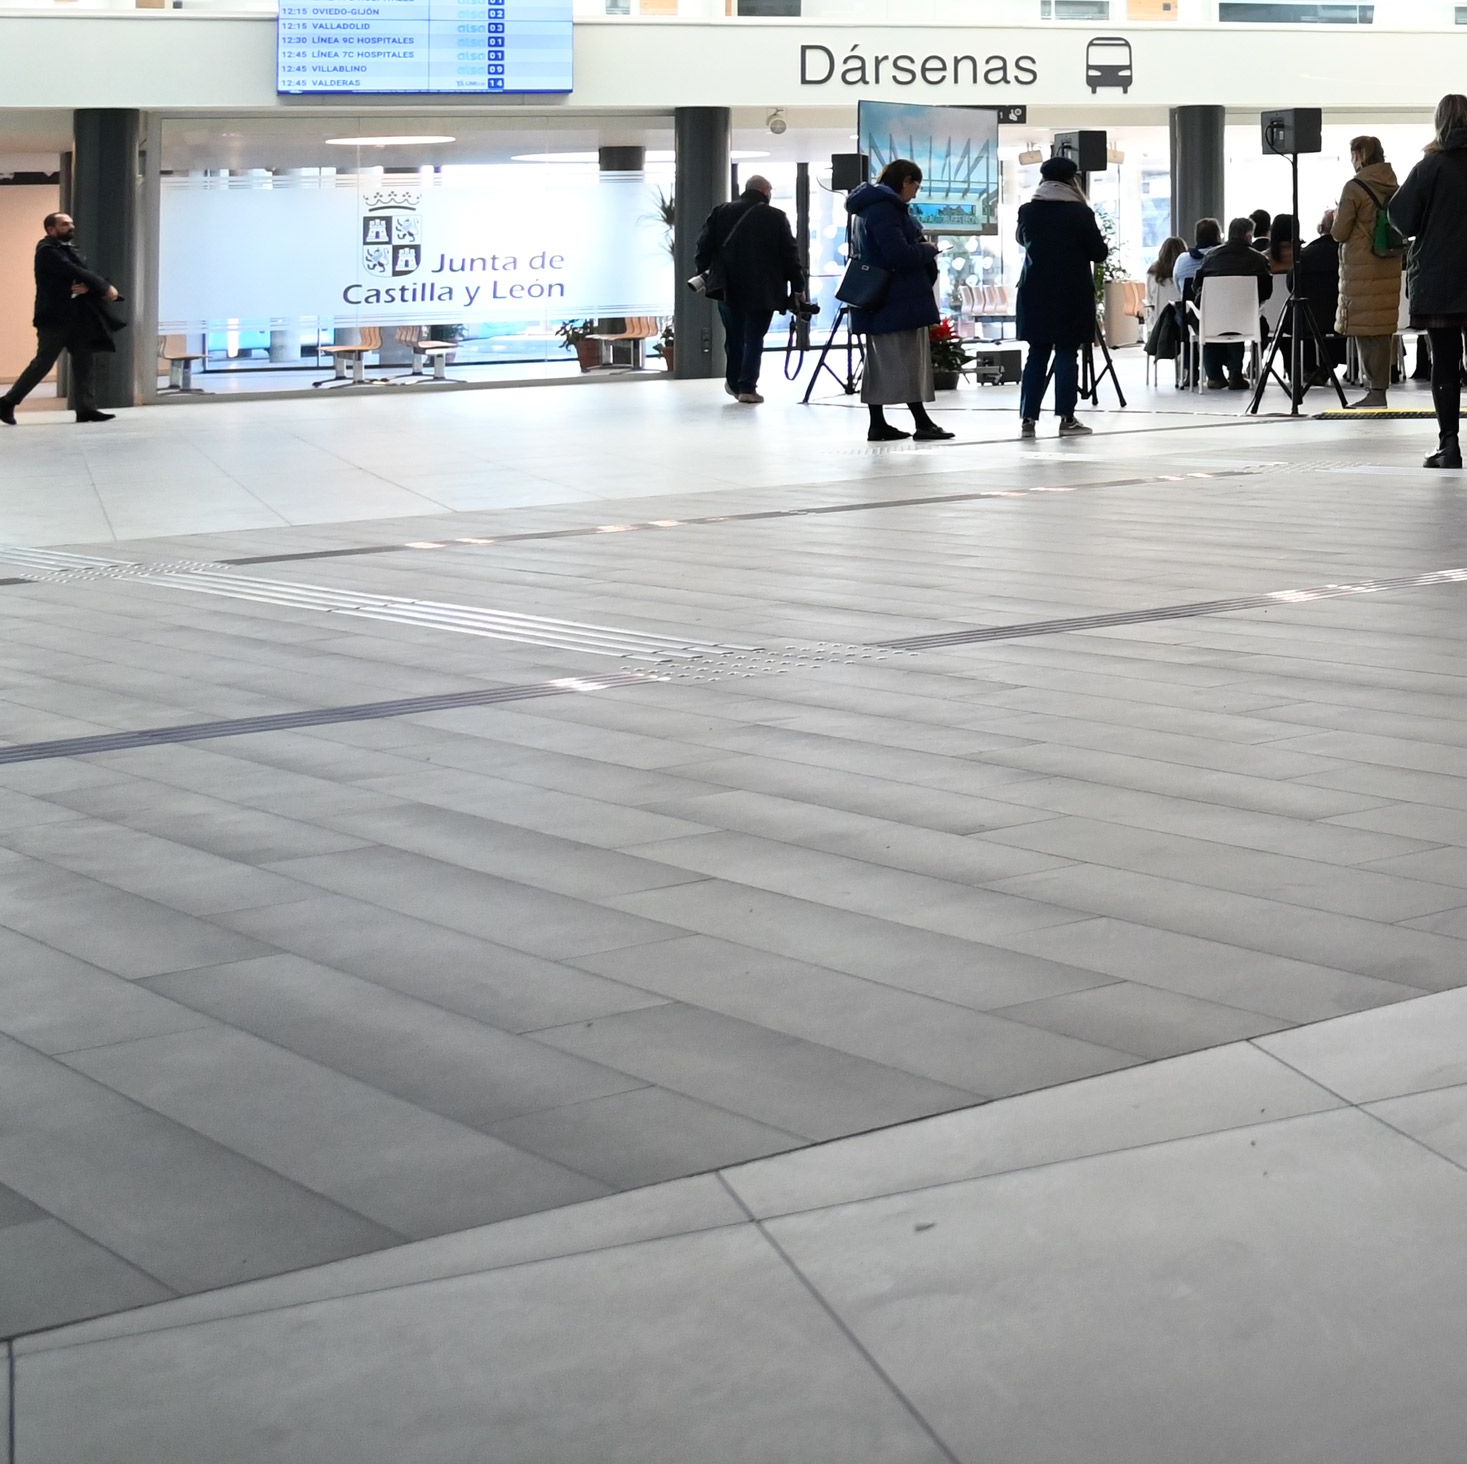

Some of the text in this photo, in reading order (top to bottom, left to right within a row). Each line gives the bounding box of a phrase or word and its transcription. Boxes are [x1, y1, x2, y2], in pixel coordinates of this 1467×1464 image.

[312, 36, 340, 44] LÍNEA
[312, 50, 340, 58] LÍNEA
[800, 44, 1038, 85] Dársenas
[431, 251, 564, 273] Junta de
[343, 279, 565, 307] Castilla y León
